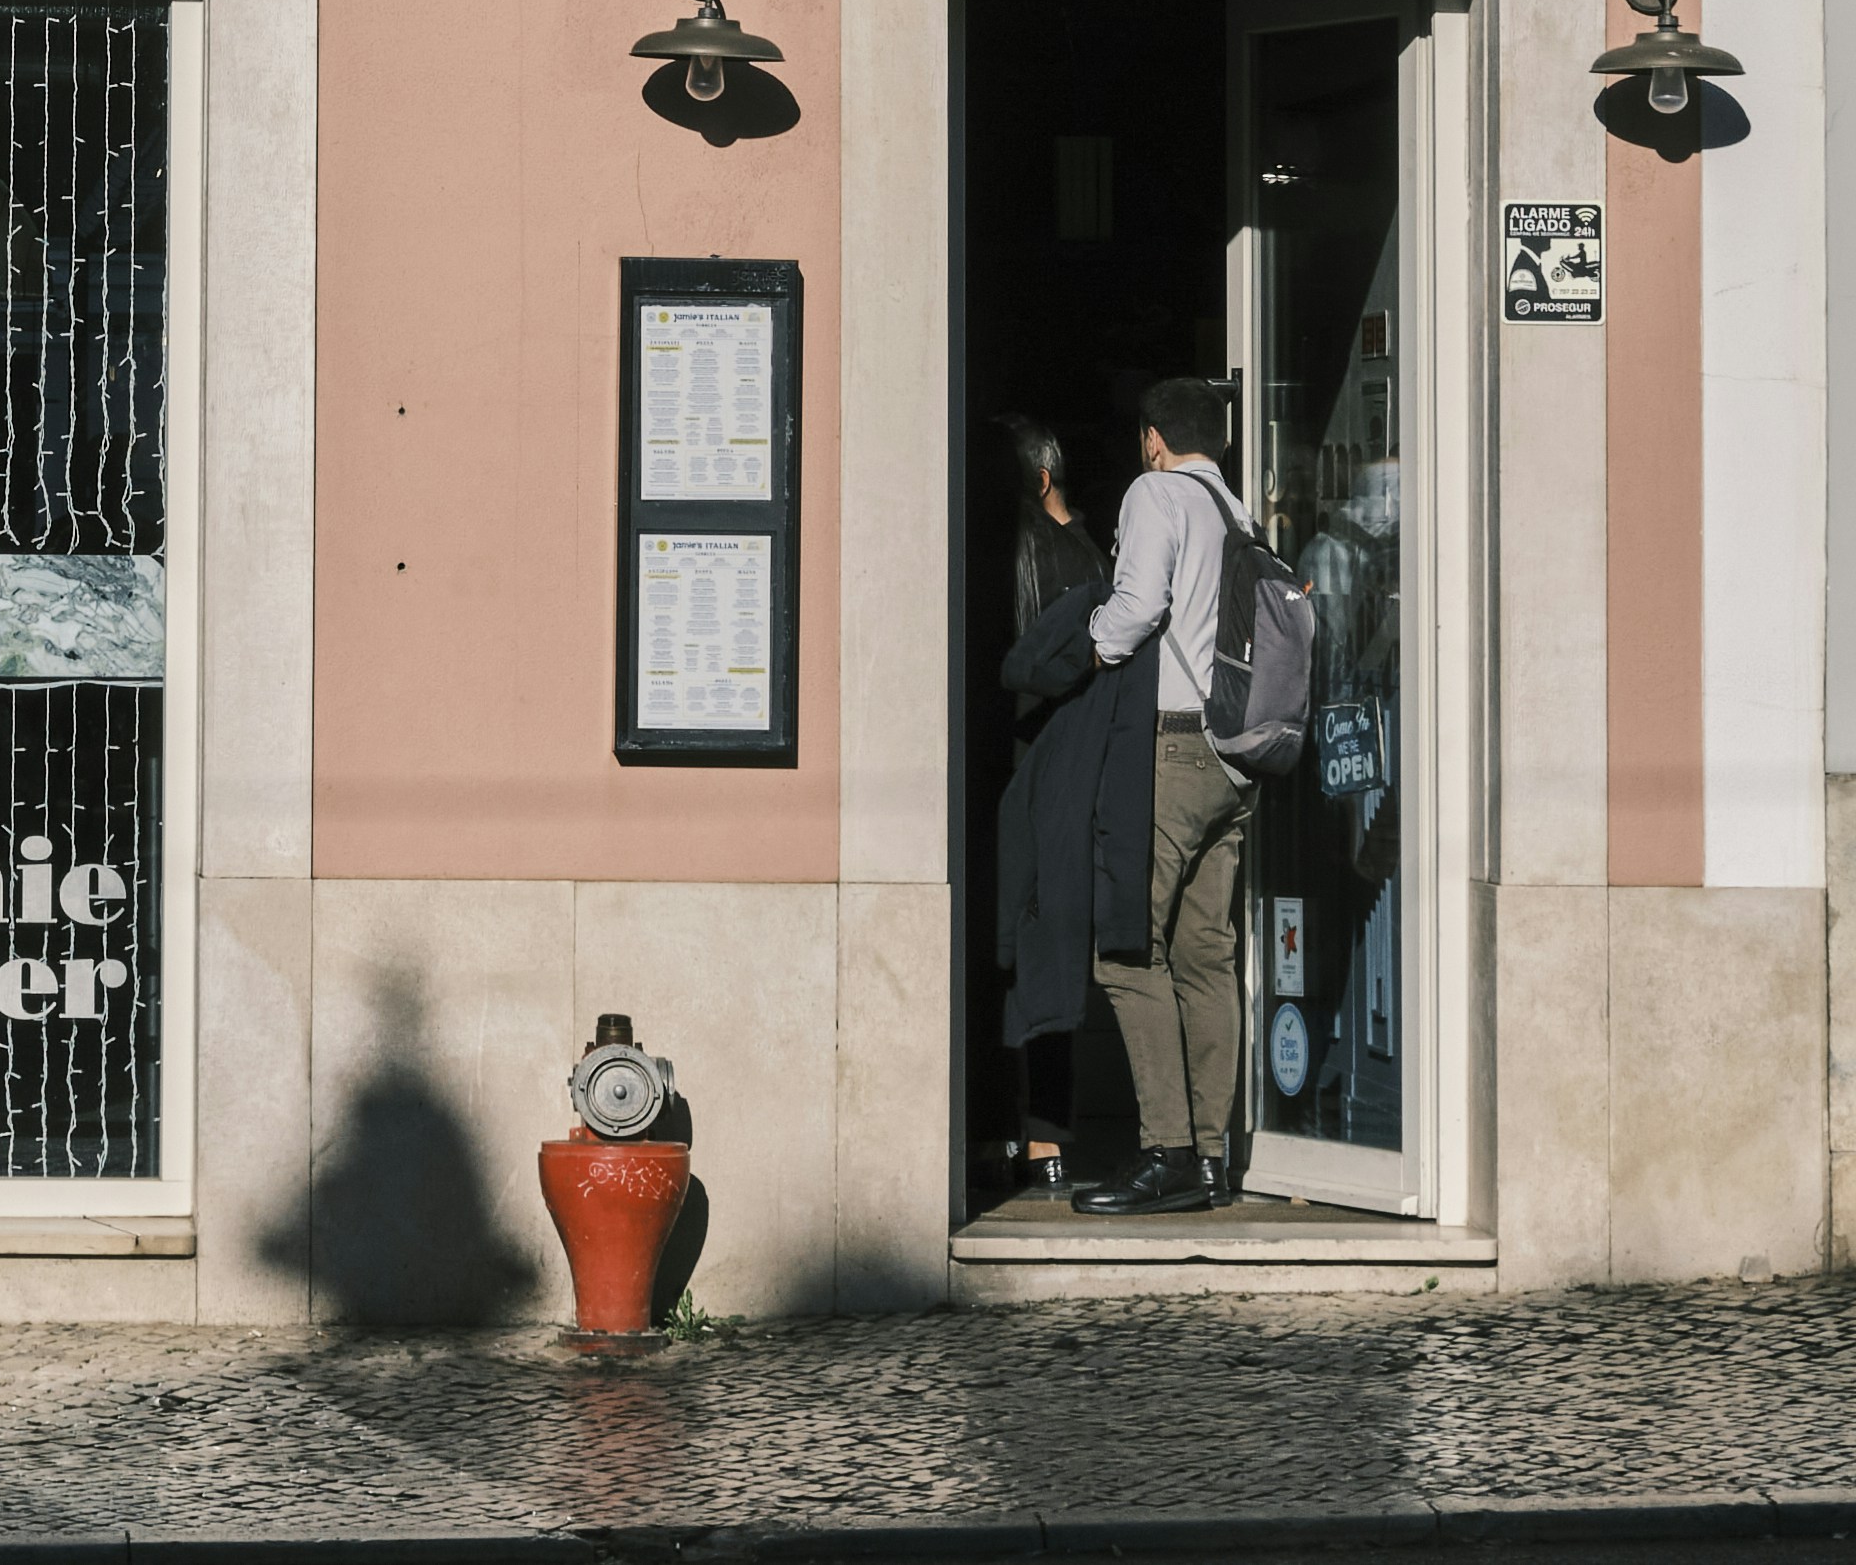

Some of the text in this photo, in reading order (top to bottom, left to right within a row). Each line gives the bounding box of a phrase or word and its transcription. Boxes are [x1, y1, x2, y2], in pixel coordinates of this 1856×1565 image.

[1509, 207, 1571, 220] ALARME
[1509, 219, 1572, 232] LIGADO
[1573, 226, 1596, 237] 24h
[1533, 302, 1592, 313] PROSEGUR
[1327, 751, 1375, 786] OPEN
